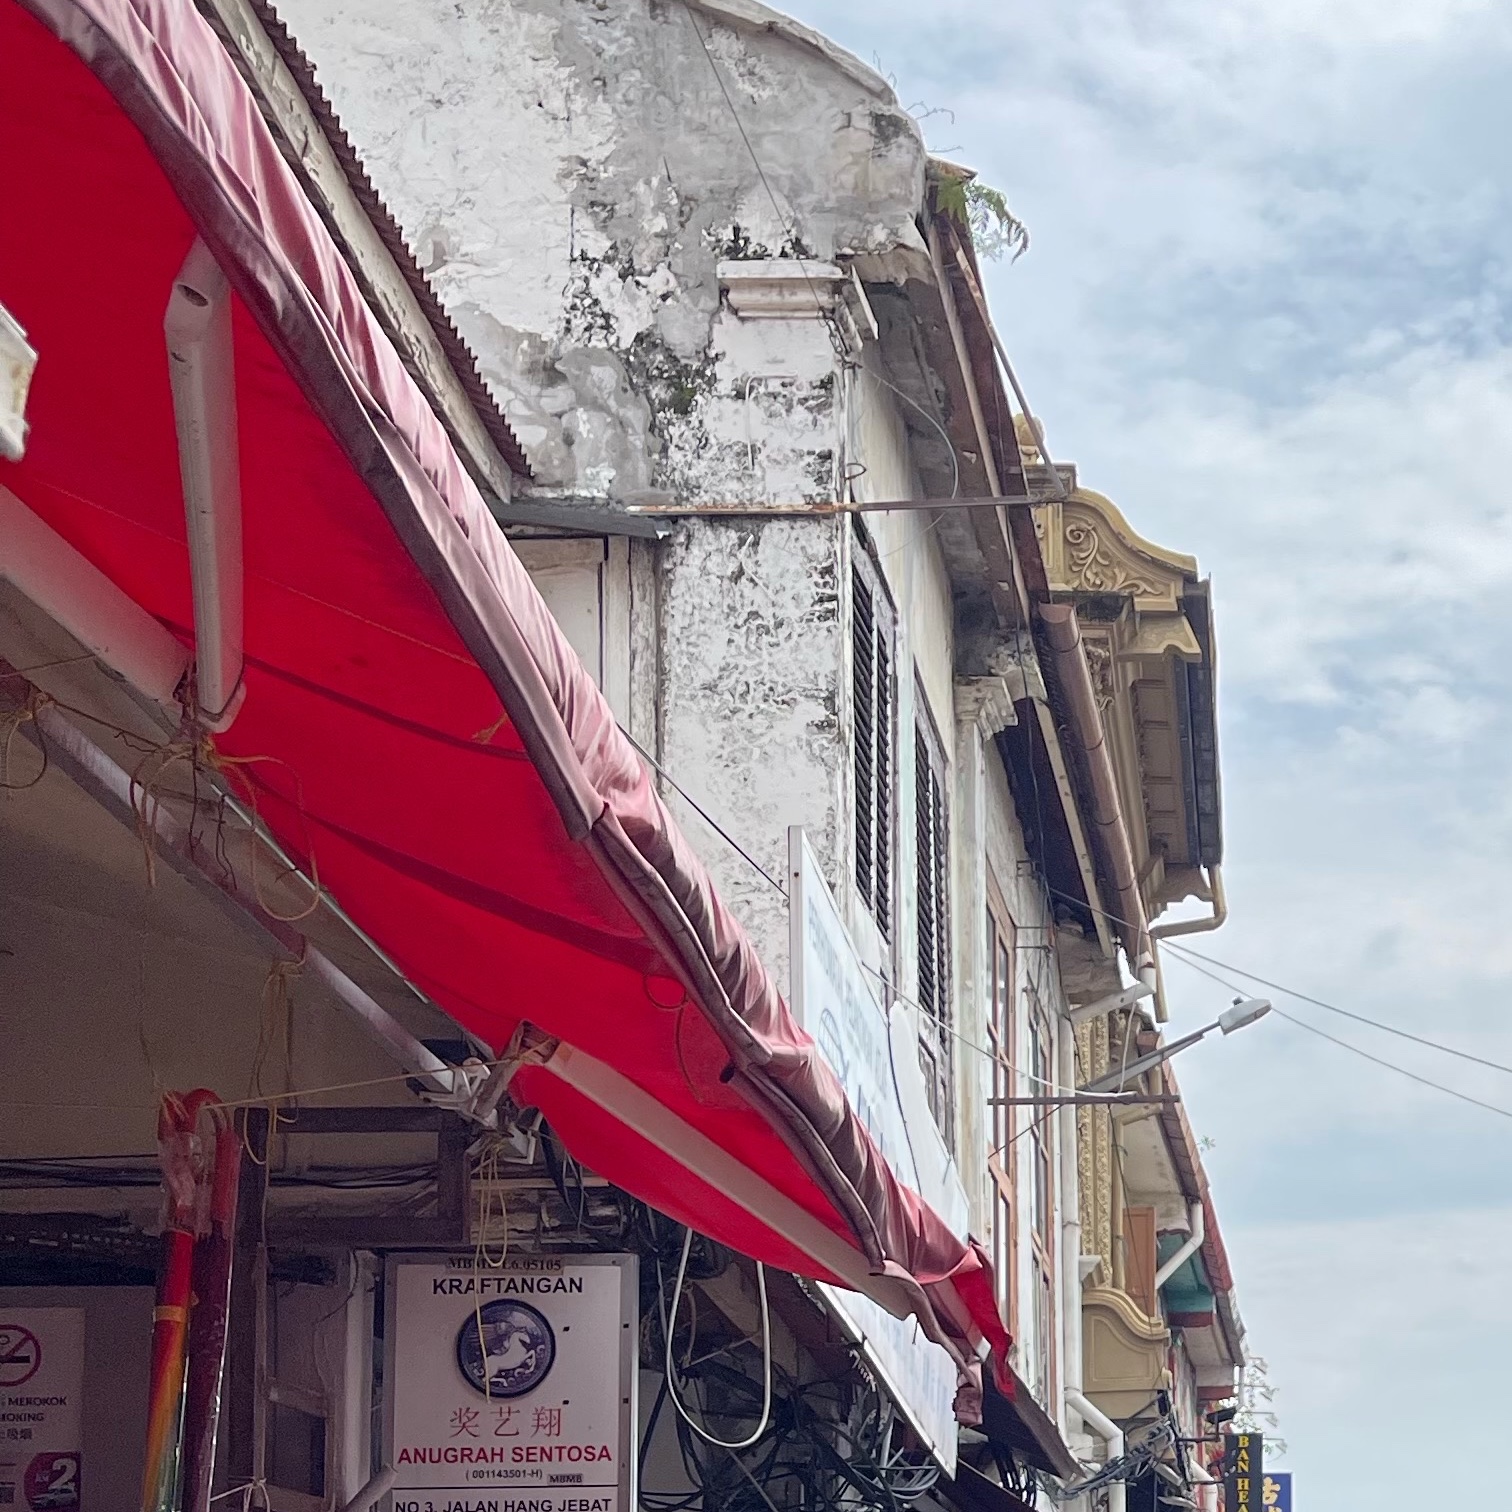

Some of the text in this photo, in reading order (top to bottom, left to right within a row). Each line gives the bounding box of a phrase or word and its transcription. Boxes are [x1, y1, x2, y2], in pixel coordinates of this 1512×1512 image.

[432, 1276, 583, 1296] KRAFTANGAN
[449, 1406, 563, 1438] 奖艺翔
[397, 1445, 612, 1464] ANUGRAH SENTOSA
[1237, 1435, 1249, 1472] BAN
[503, 1499, 552, 1512] HANG
[557, 1499, 612, 1512] JEBAT
